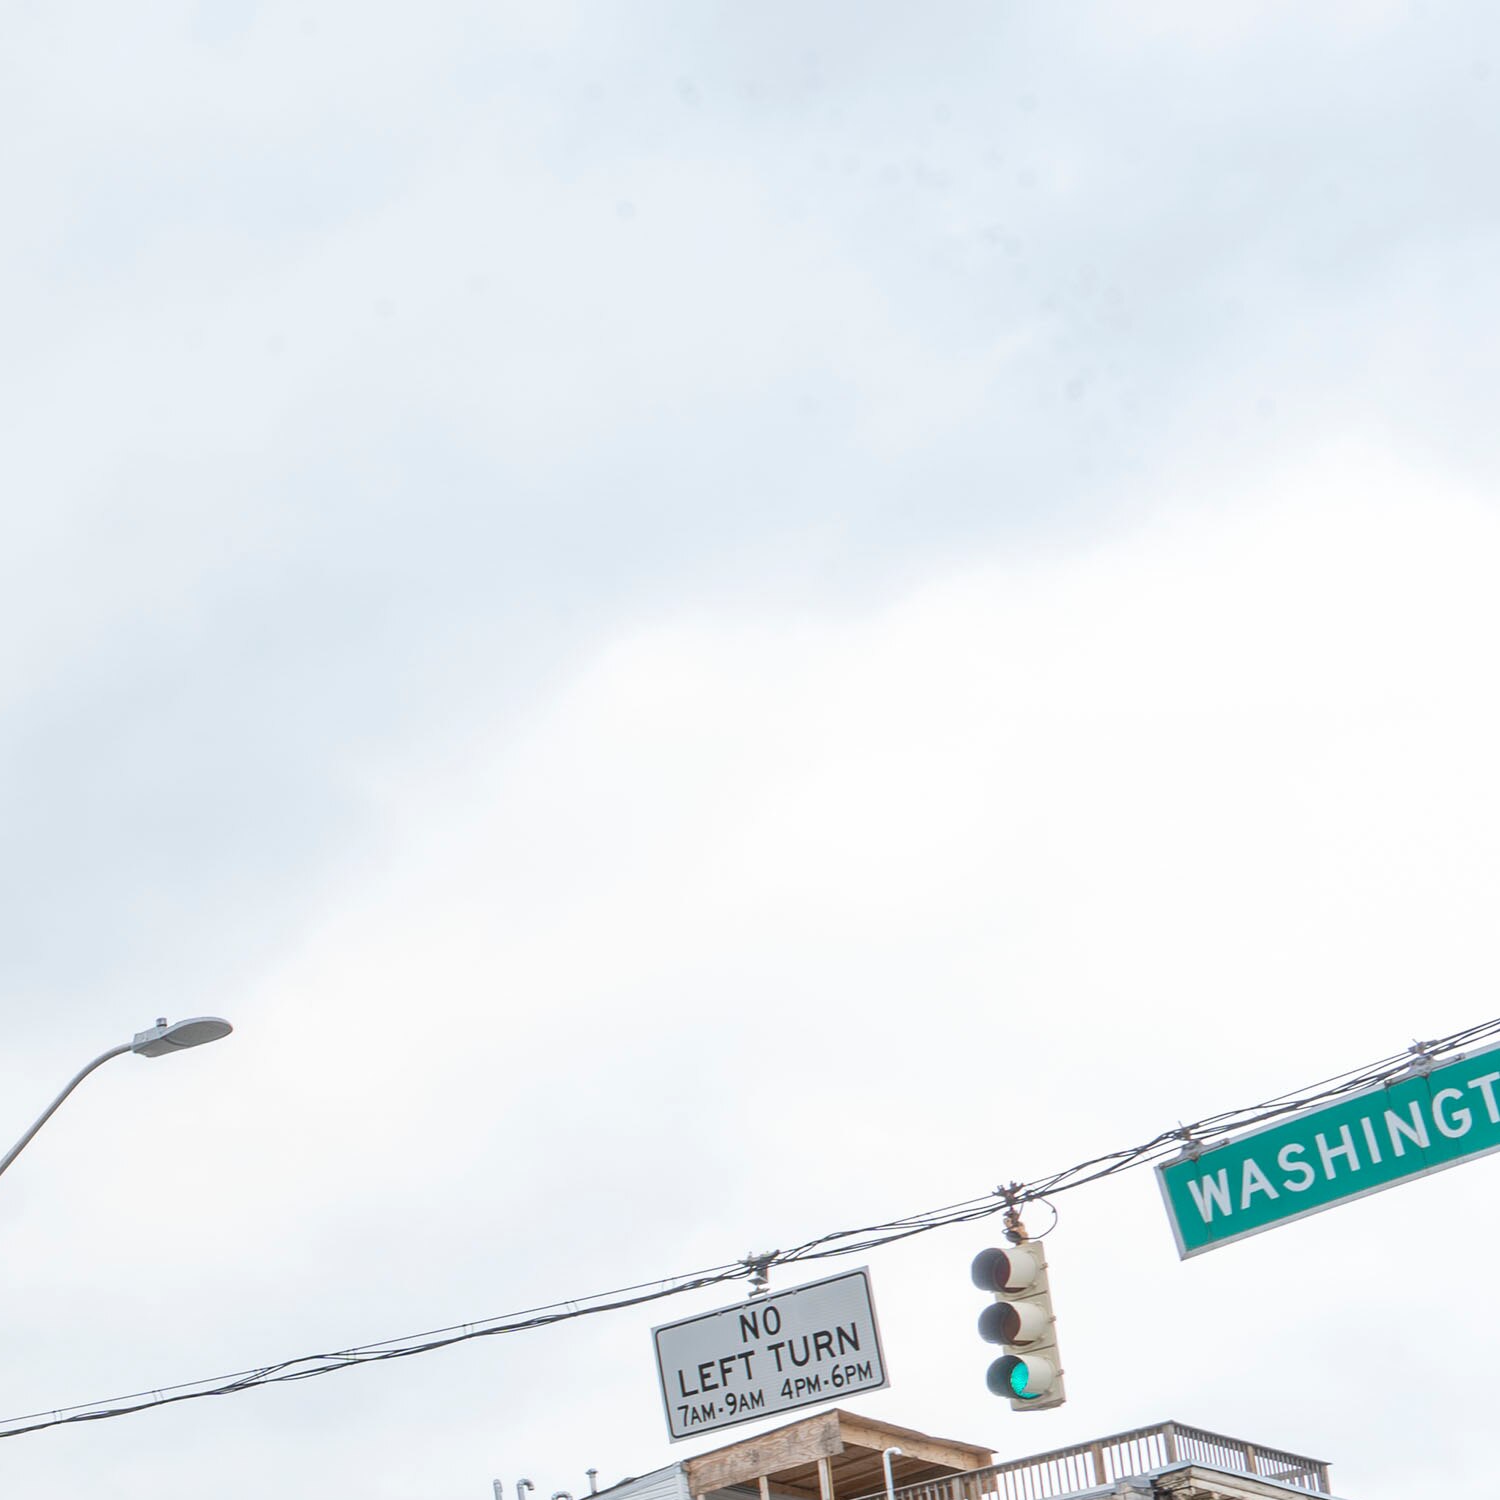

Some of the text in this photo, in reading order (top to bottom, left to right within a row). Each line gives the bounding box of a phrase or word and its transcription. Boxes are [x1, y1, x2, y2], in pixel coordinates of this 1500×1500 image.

[739, 1305, 782, 1343] NO
[678, 1322, 861, 1398] LEFT TURN
